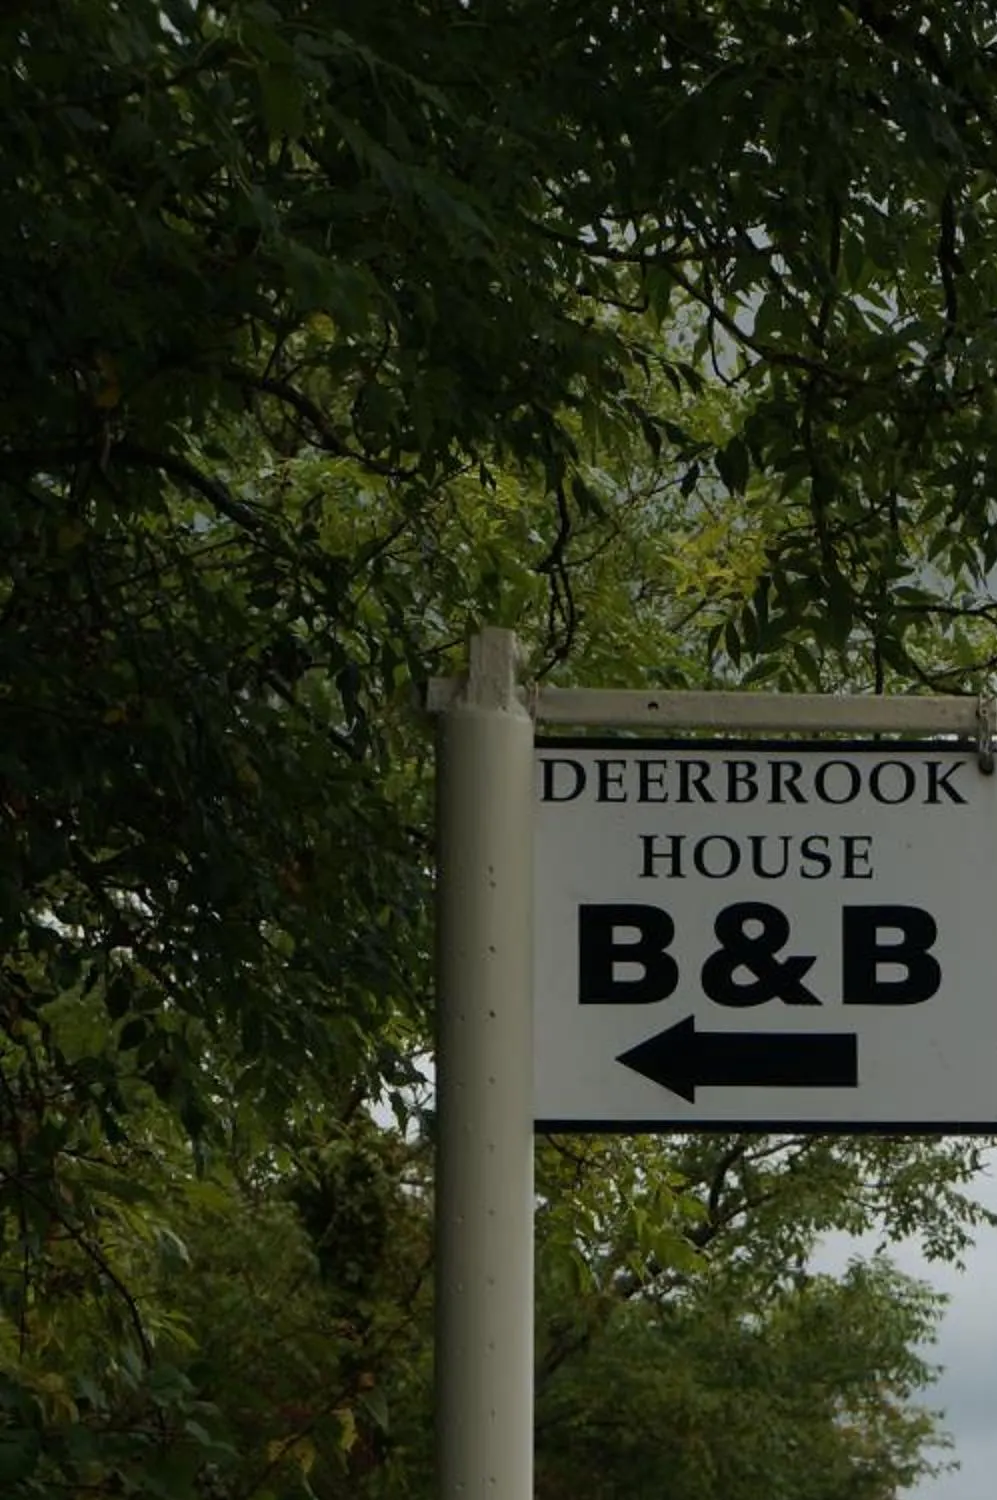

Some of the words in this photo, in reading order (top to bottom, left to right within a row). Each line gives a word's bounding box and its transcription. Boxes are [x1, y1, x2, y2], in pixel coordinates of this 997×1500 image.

[540, 758, 968, 804] DEERBROOK
[638, 835, 874, 879] HOUSE
[578, 901, 942, 1007] B&B
